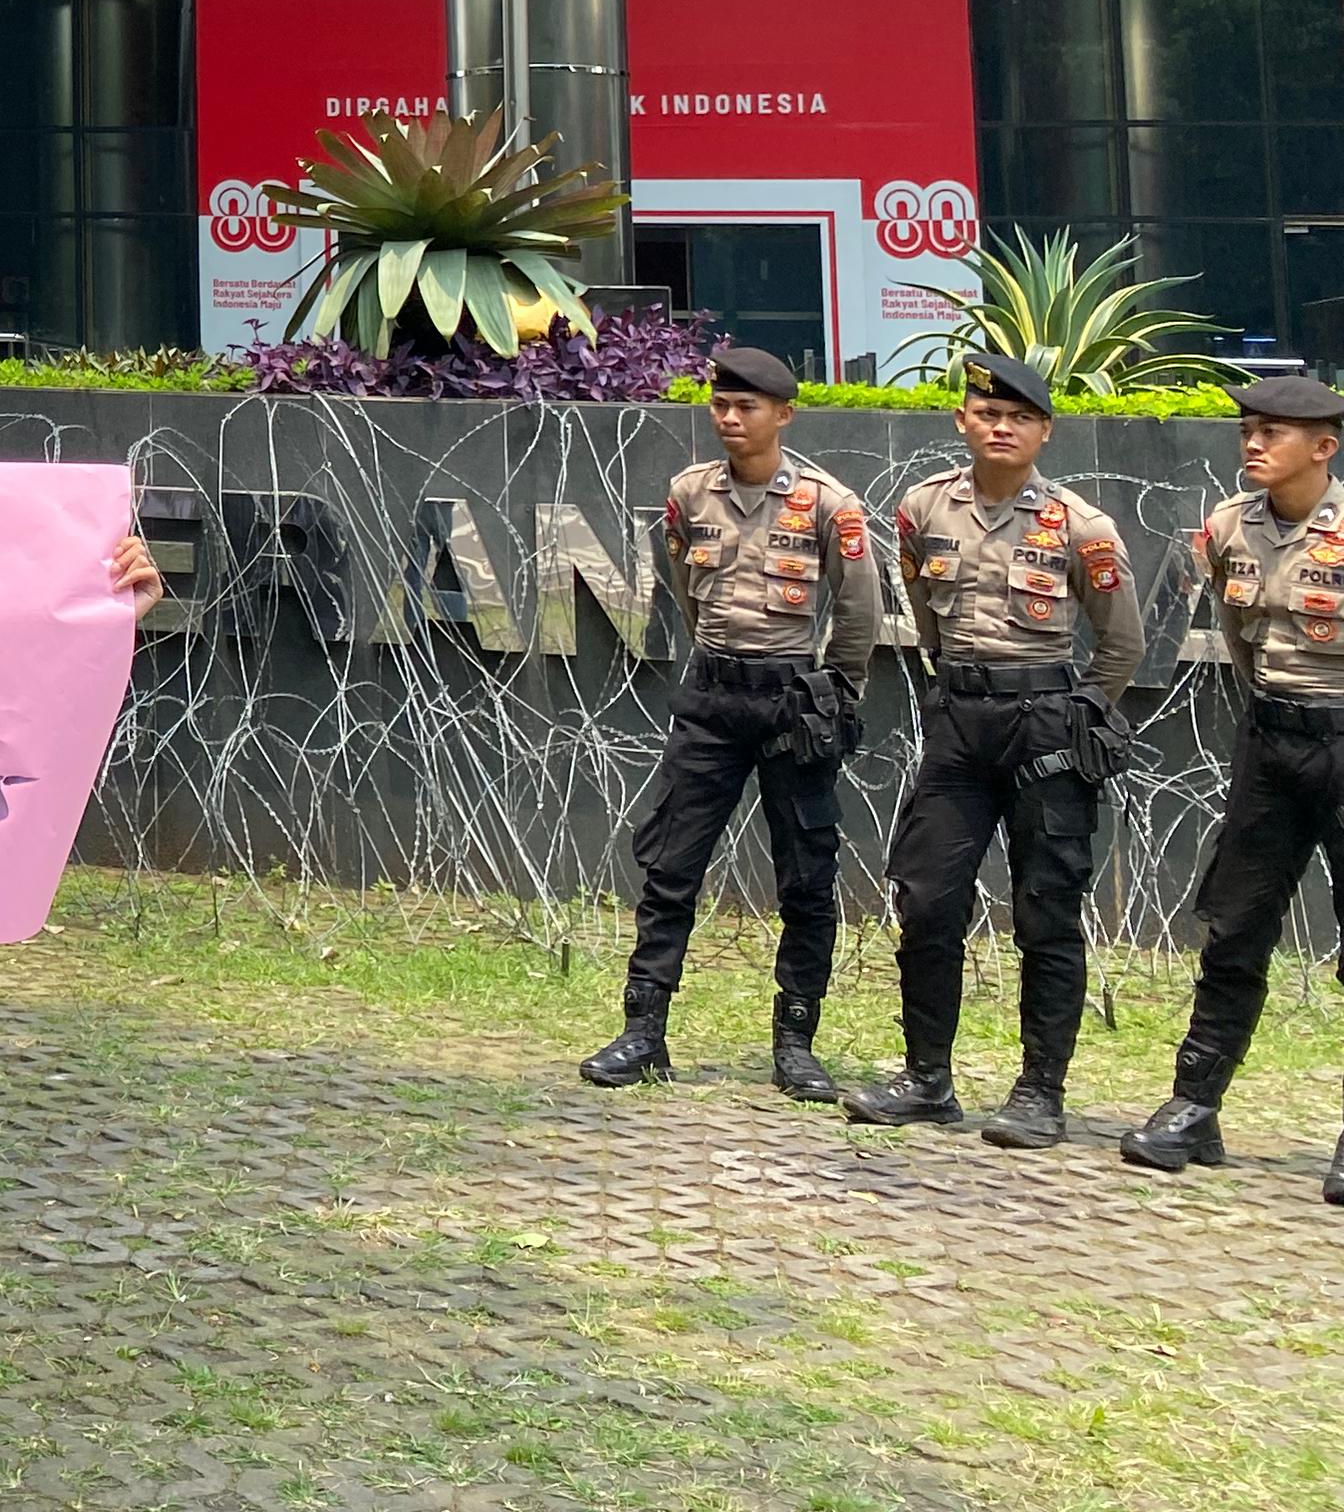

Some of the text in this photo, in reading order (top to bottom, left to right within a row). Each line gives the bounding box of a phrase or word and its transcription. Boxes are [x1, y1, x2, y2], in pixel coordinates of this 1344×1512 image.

[662, 93, 828, 116] INDONESIA
[874, 180, 978, 260] 80
[251, 279, 296, 290] Berdaat
[1013, 547, 1068, 570] POLRI
[1298, 568, 1344, 585] POLR
